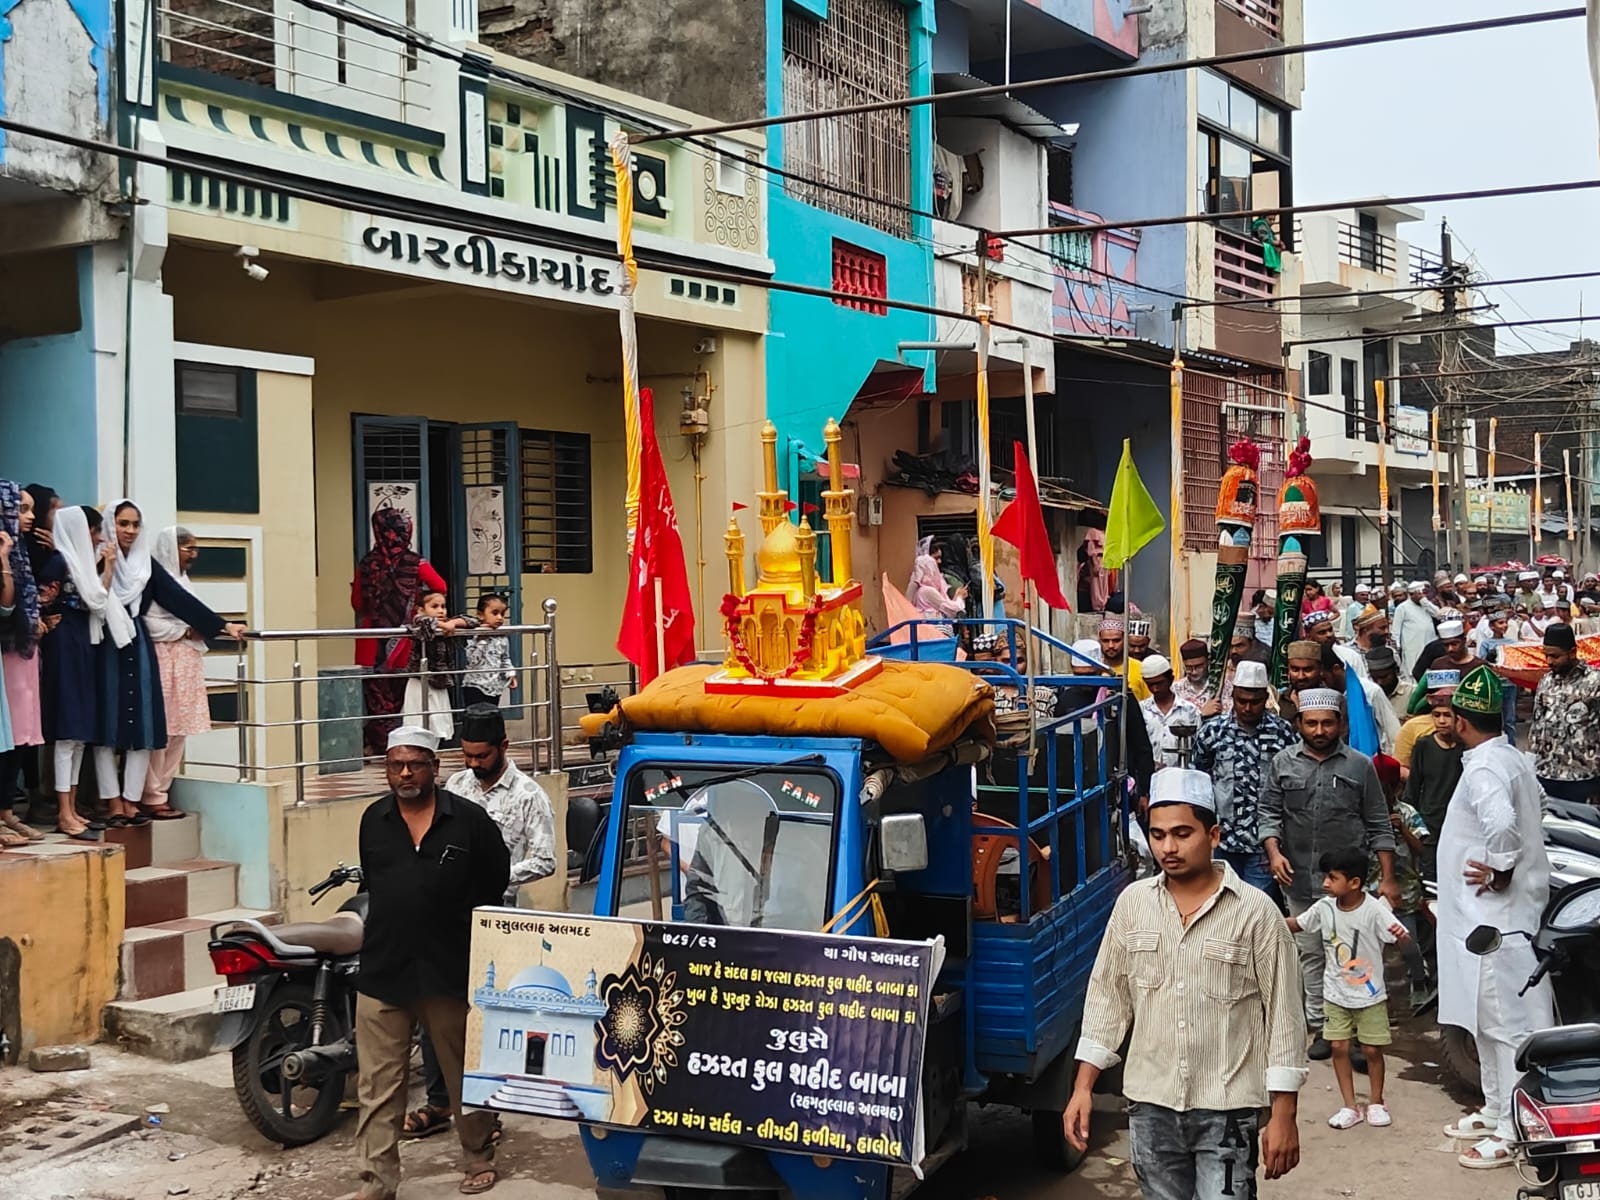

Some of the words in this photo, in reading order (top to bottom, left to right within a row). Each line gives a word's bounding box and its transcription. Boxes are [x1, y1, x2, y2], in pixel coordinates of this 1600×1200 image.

[780, 779, 822, 809] F.A.M
[480, 918, 492, 929] યા
[823, 946, 838, 960] યા
[688, 962, 712, 977] આજ
[750, 968, 762, 982] કા
[876, 981, 904, 996] બાબા
[906, 984, 919, 998] કા
[870, 1007, 900, 1023] બાબા
[904, 1010, 916, 1024] કા
[687, 1052, 748, 1079] હઝરત
[789, 1057, 843, 1090] શહીદ
[849, 1071, 907, 1099] બાબા
